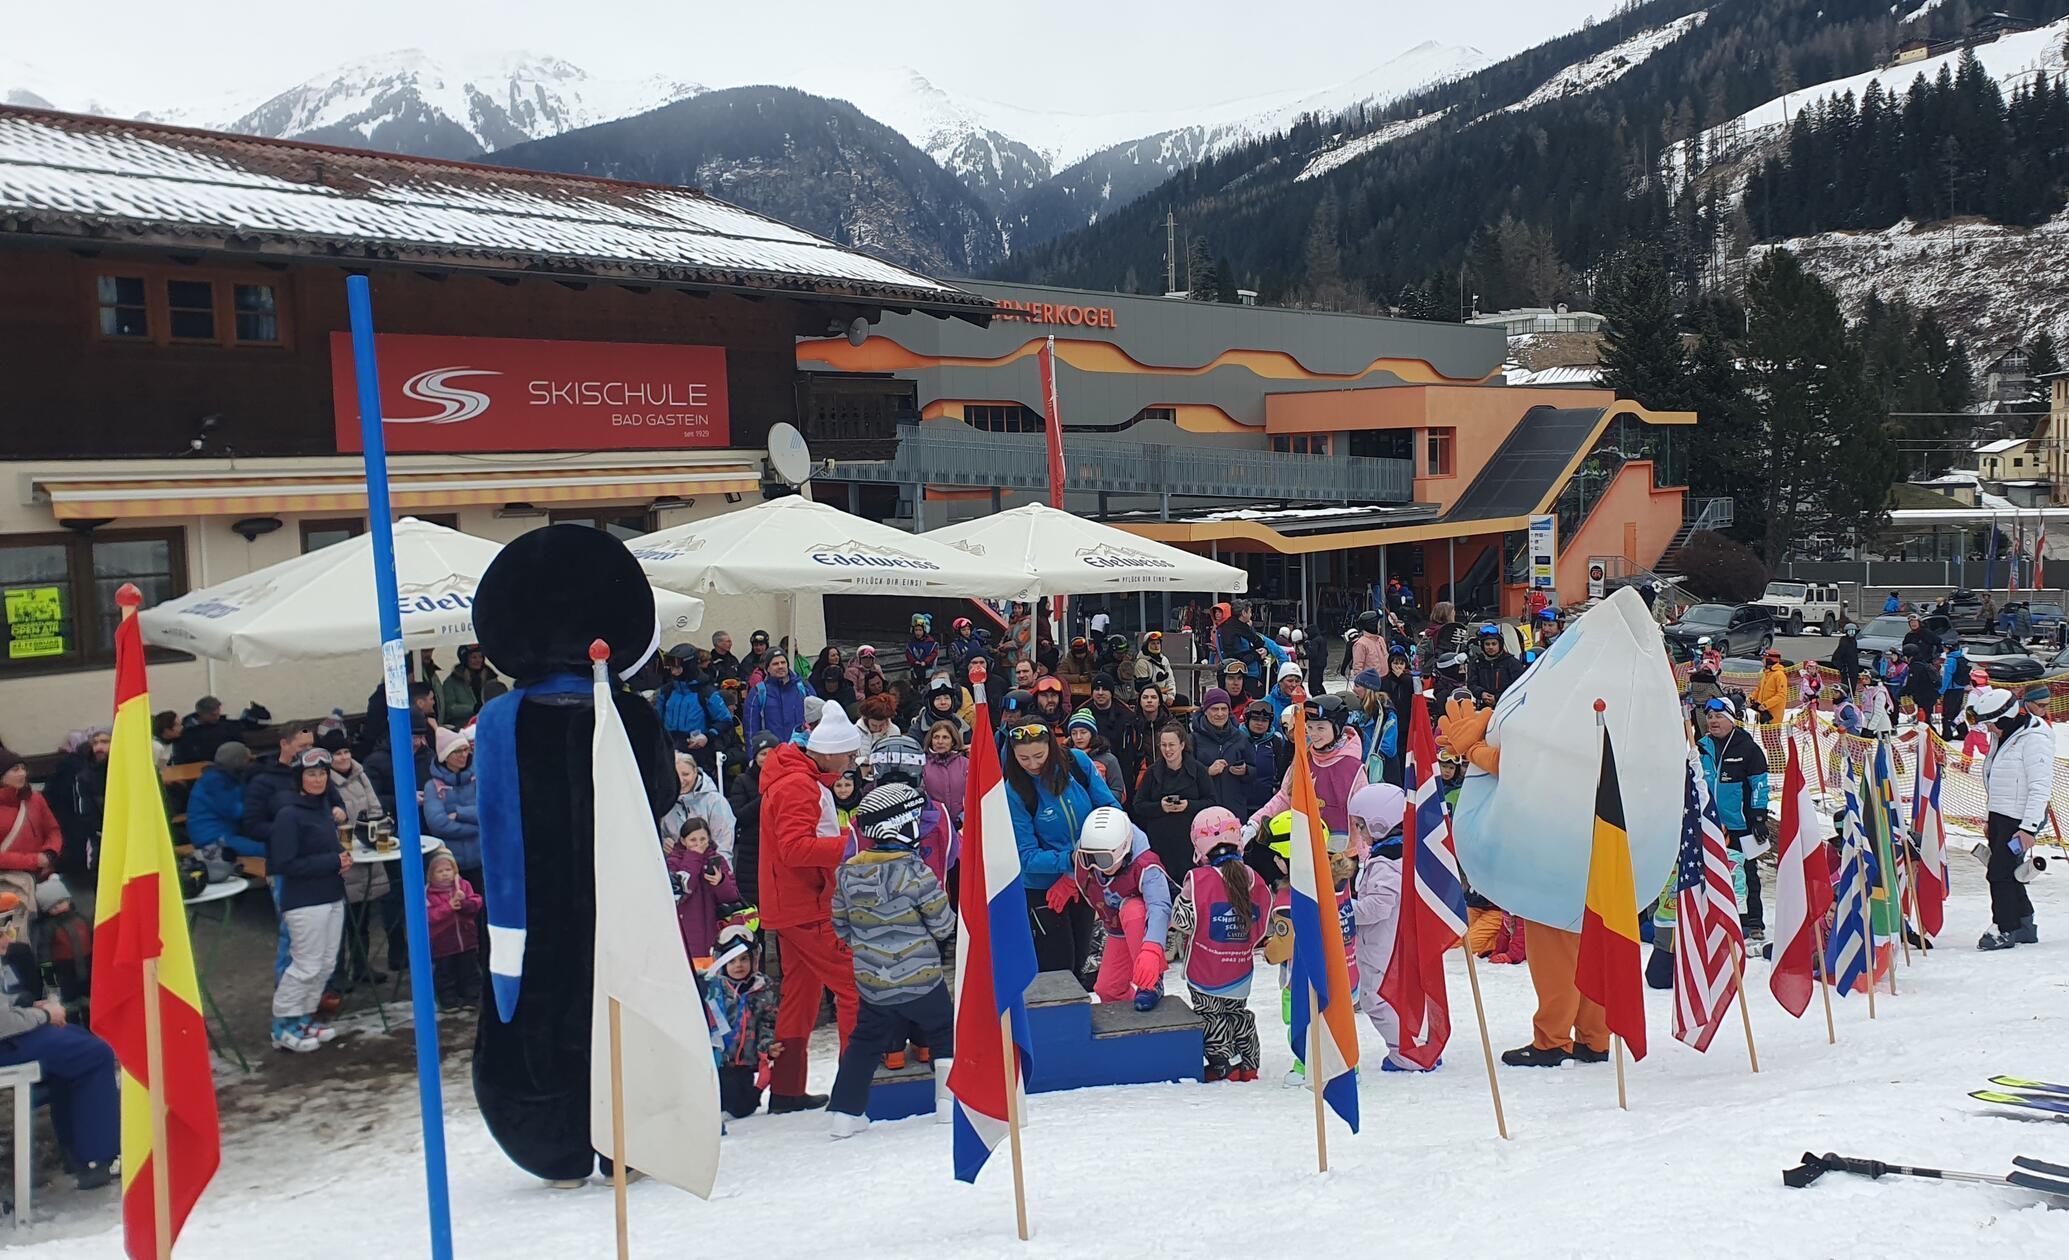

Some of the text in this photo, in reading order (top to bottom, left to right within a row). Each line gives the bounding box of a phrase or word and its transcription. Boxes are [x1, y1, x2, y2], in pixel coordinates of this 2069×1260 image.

[528, 380, 708, 407] SKISCHULE
[611, 413, 709, 426] BAD GASTEIN
[812, 553, 940, 570] Edelweiss
[1083, 556, 1175, 568] Edelweiss
[856, 576, 883, 586] PFLÜCK
[886, 577, 899, 586] DIR
[441, 622, 473, 635] PFLÜC
[903, 797, 925, 809] HEAD
